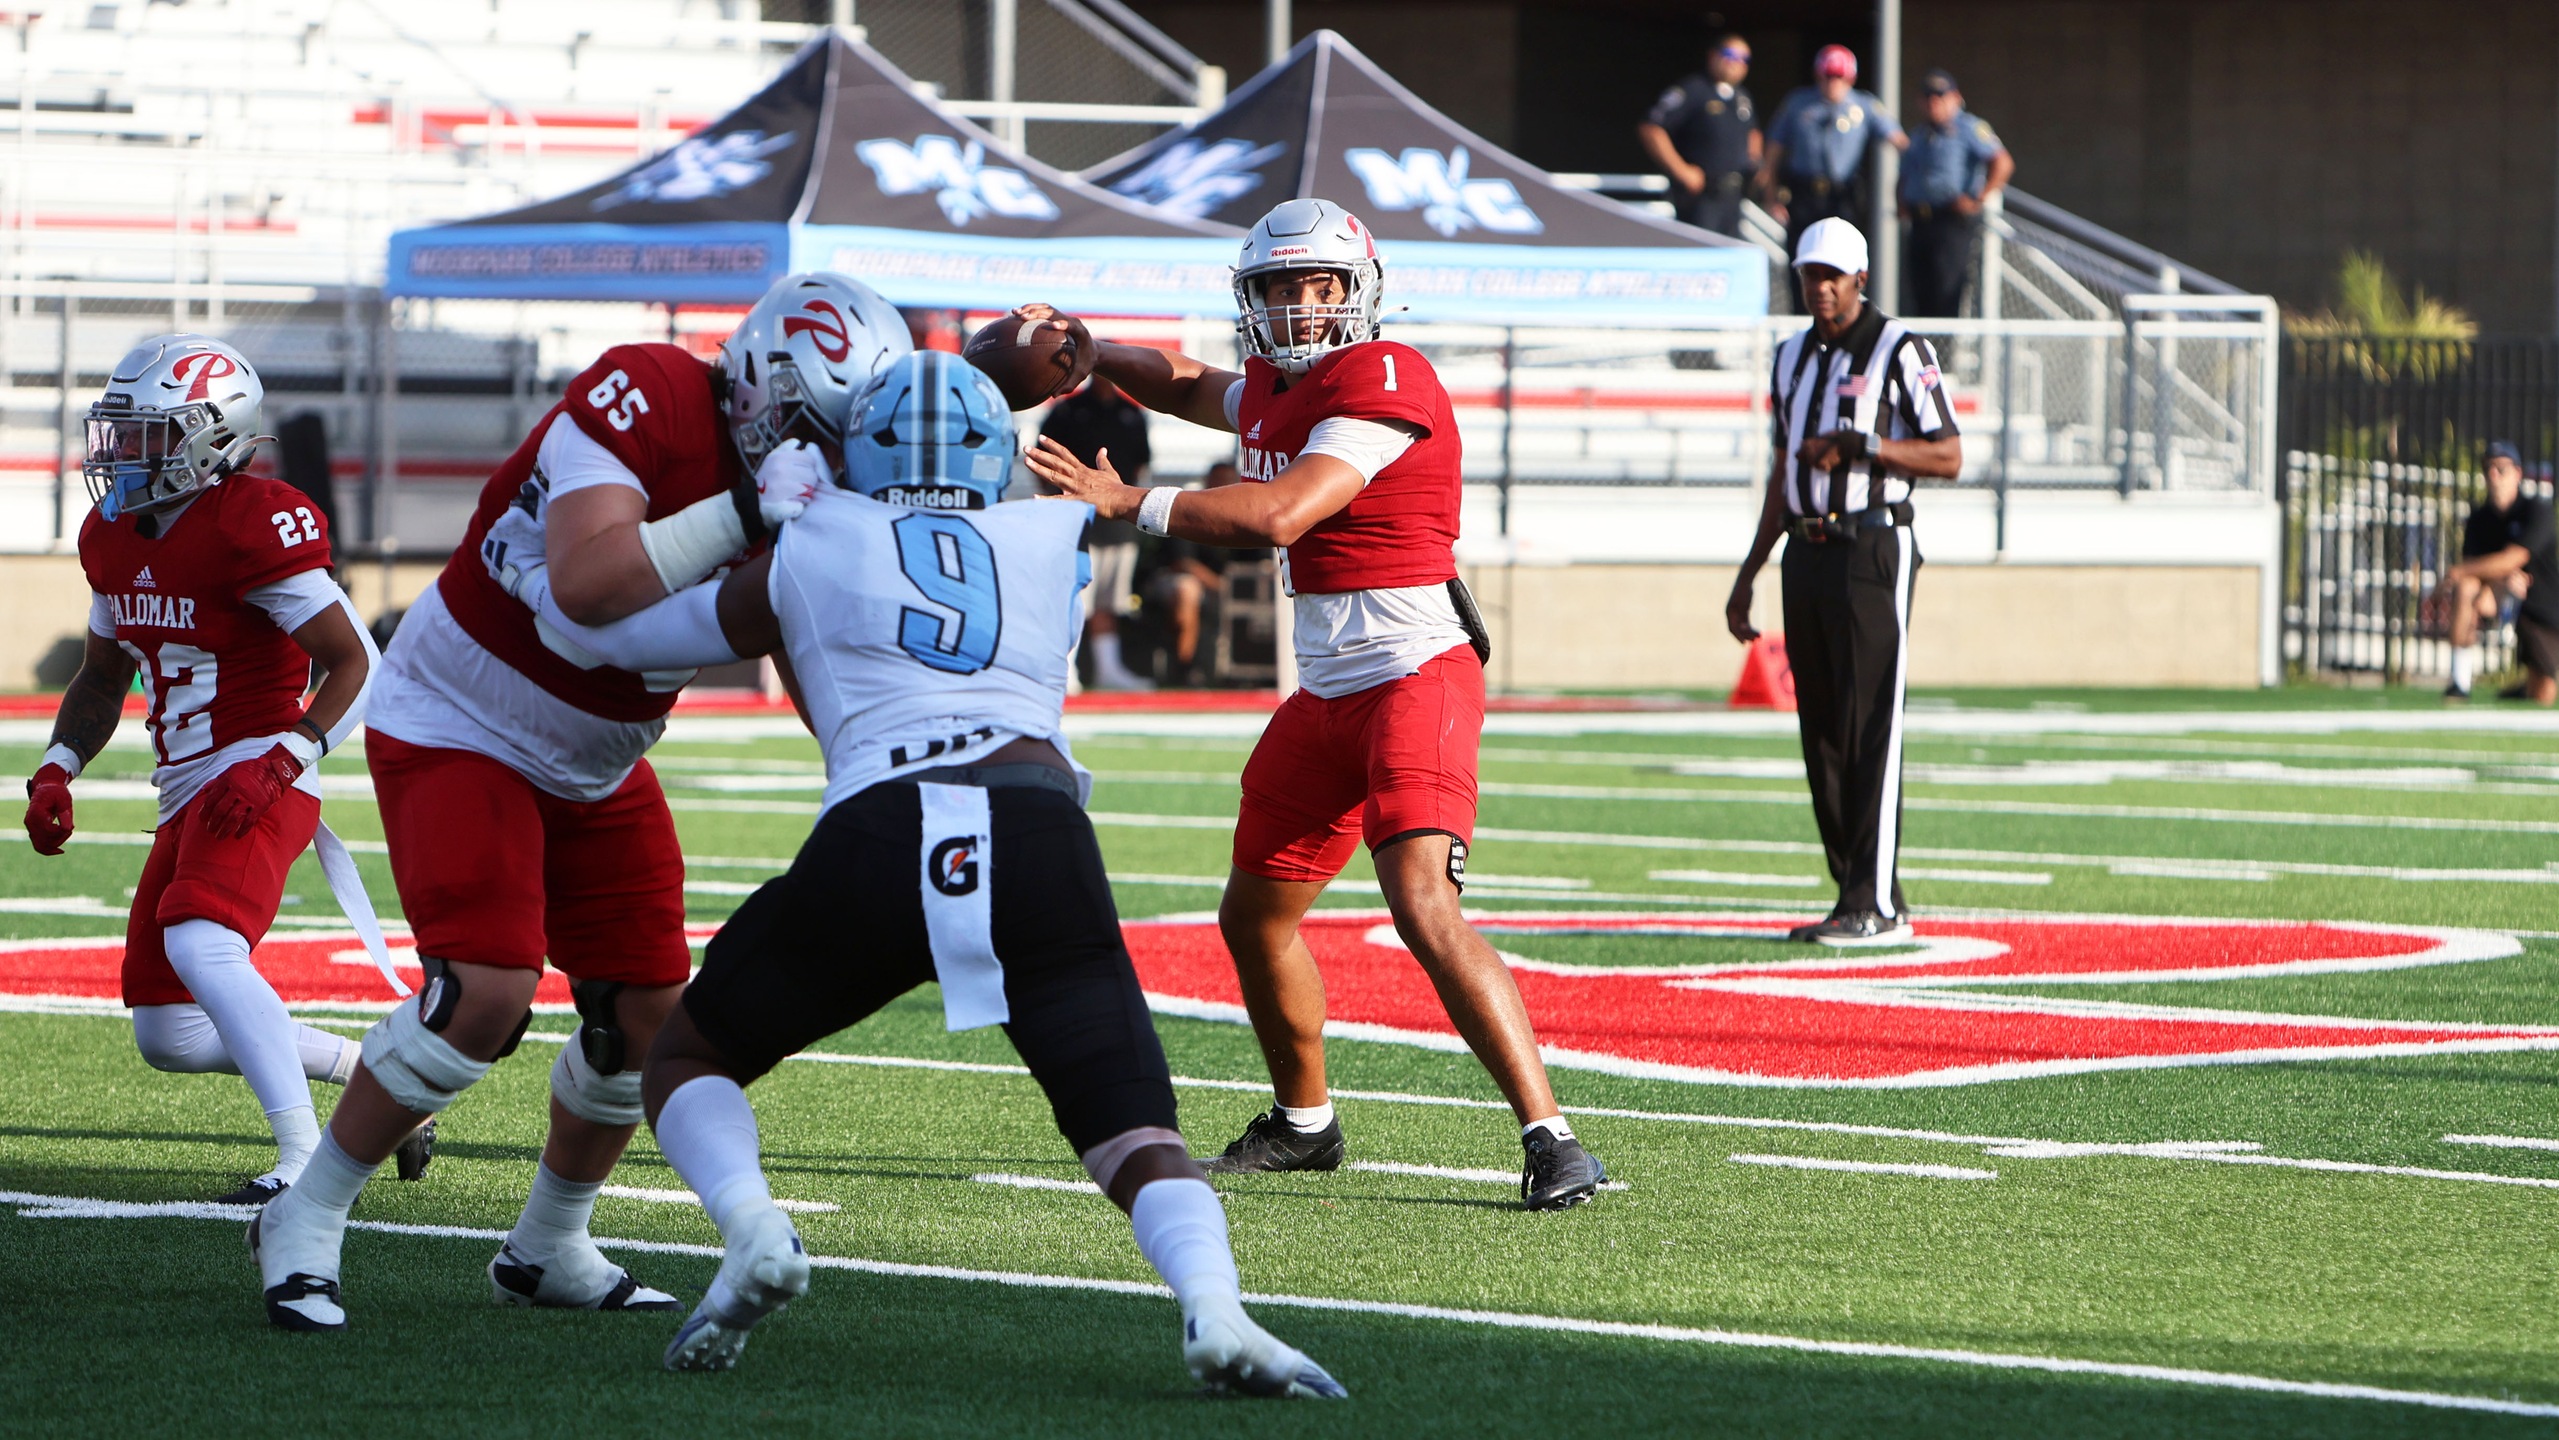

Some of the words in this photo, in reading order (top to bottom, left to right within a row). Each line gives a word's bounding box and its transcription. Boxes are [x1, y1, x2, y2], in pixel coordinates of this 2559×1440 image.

[1271, 248, 1308, 257] Riddell
[1102, 261, 1231, 291] ATHLETIC
[783, 299, 853, 364] P
[172, 353, 236, 403] P
[1382, 354, 1398, 391] 1
[588, 369, 650, 431] 65
[888, 488, 969, 508] Riddell
[271, 507, 320, 549] 22
[132, 579, 156, 588] adidas
[891, 512, 1002, 676] 9
[928, 835, 978, 896] G
